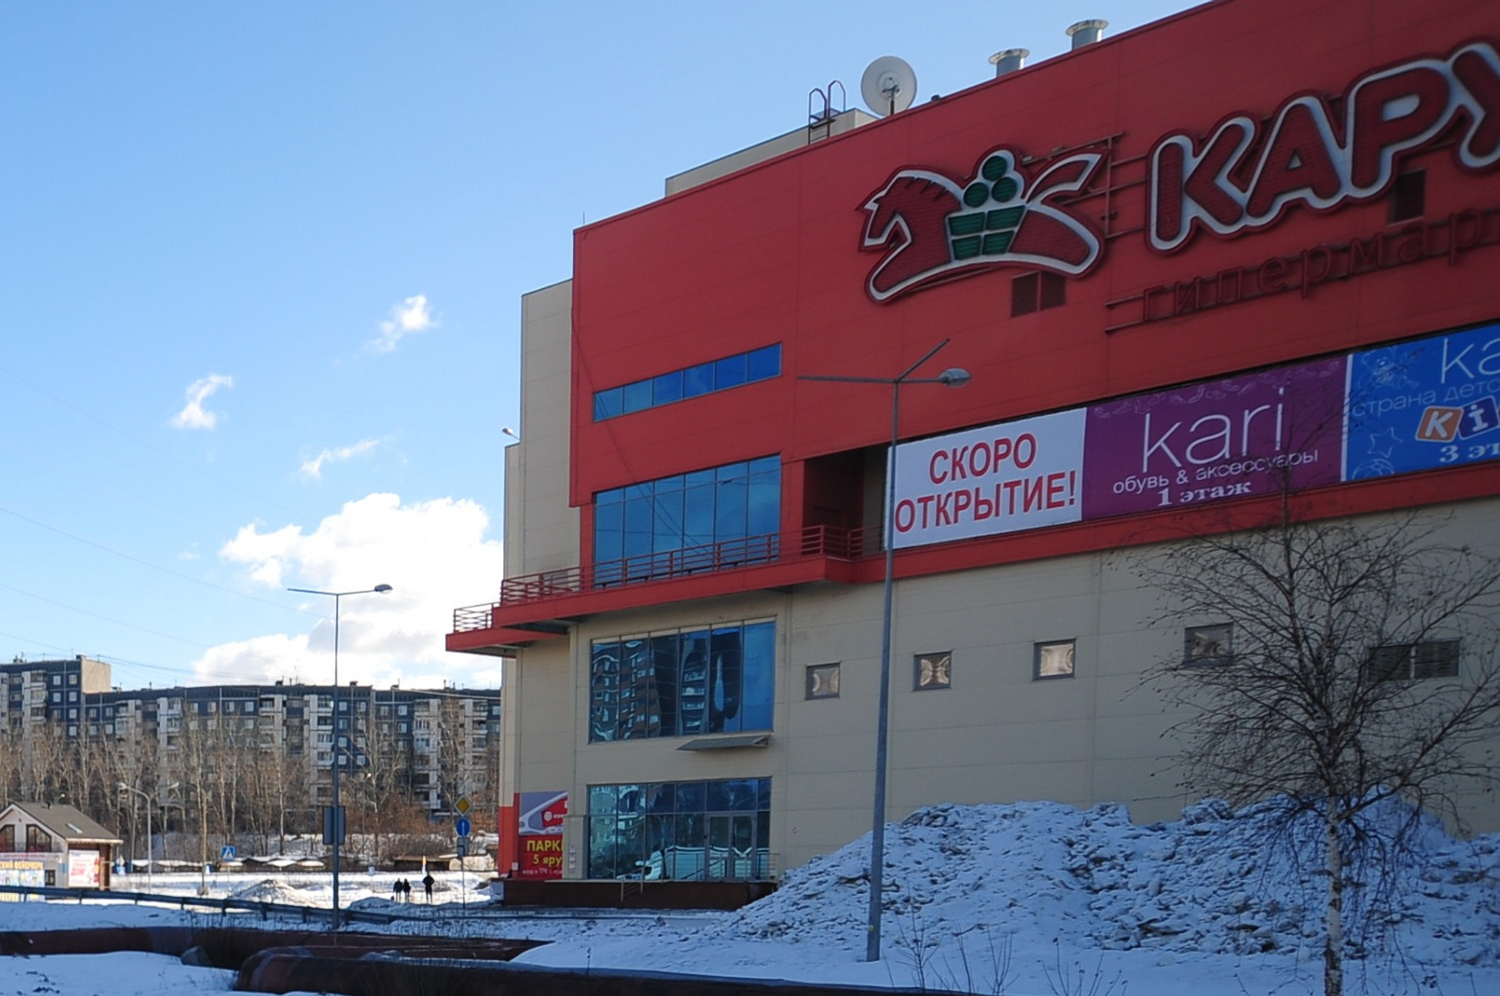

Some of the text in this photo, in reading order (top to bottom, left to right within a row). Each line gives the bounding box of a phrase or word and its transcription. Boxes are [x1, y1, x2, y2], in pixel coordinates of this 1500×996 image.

[1352, 390, 1437, 417] страна
[1142, 388, 1284, 473] kari
[929, 433, 1037, 484] СКОРО
[1439, 445, 1459, 463] 3
[1112, 450, 1318, 494] обувь & аксессуары
[895, 470, 1076, 533] ОТКРЫТИЕ!
[1158, 482, 1252, 506] 1 этаж
[526, 840, 563, 851] ПАРК
[533, 853, 540, 864] 5
